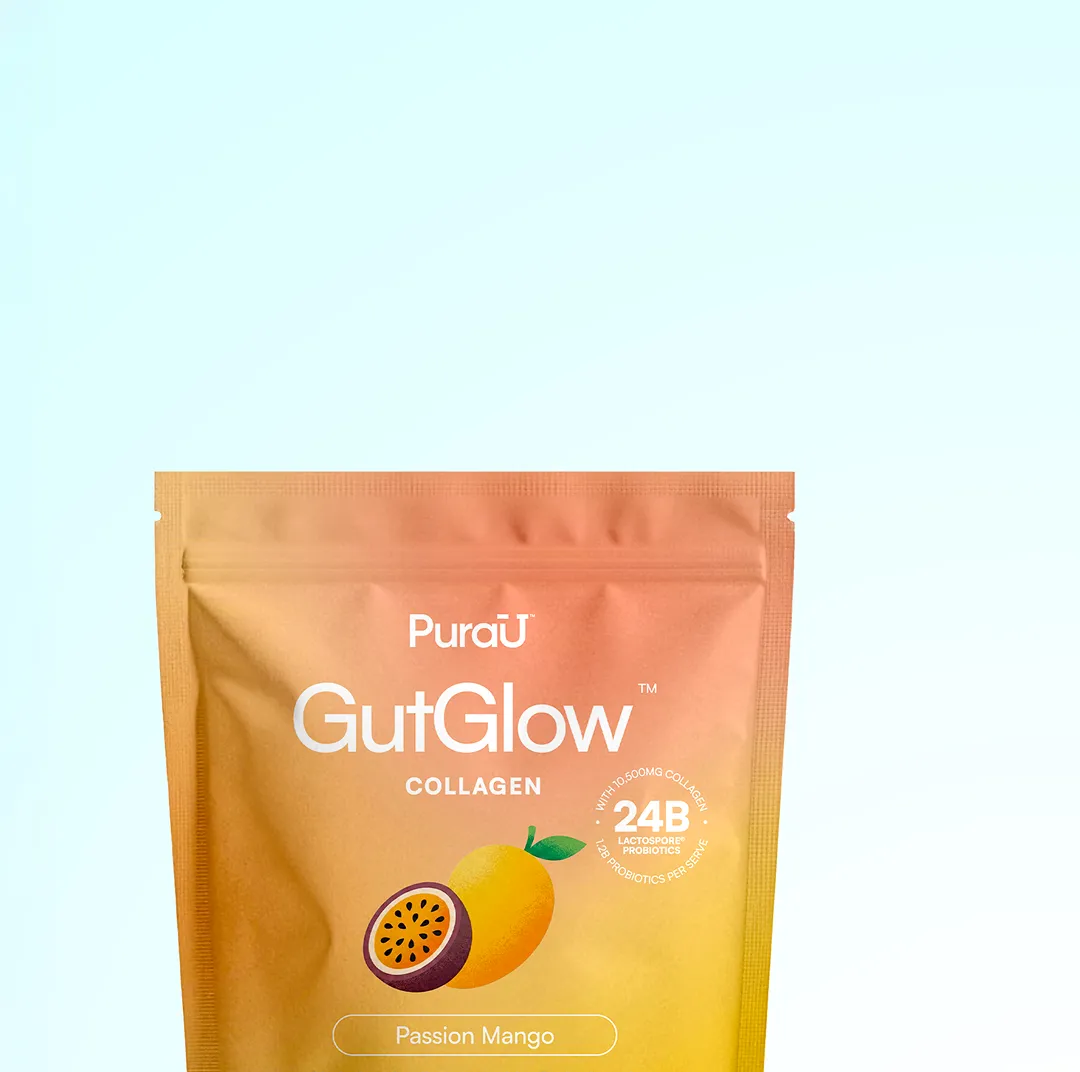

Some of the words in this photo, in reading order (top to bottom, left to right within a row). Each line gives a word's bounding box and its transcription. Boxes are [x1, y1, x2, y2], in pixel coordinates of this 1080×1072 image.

[405, 776, 541, 796] COLLAGEN
[595, 785, 616, 811] WITH
[612, 767, 663, 788] 10,500MG
[665, 769, 708, 812] COLLAGEN
[613, 799, 690, 832] 24B
[595, 838, 611, 859] 1.2B
[607, 857, 666, 885] PROBIOTICS
[667, 865, 687, 881] PER
[685, 838, 709, 869] SERVE
[621, 845, 682, 856] PROBIOTICS
[395, 1025, 475, 1045] Passion
[483, 1026, 554, 1049] Mango
